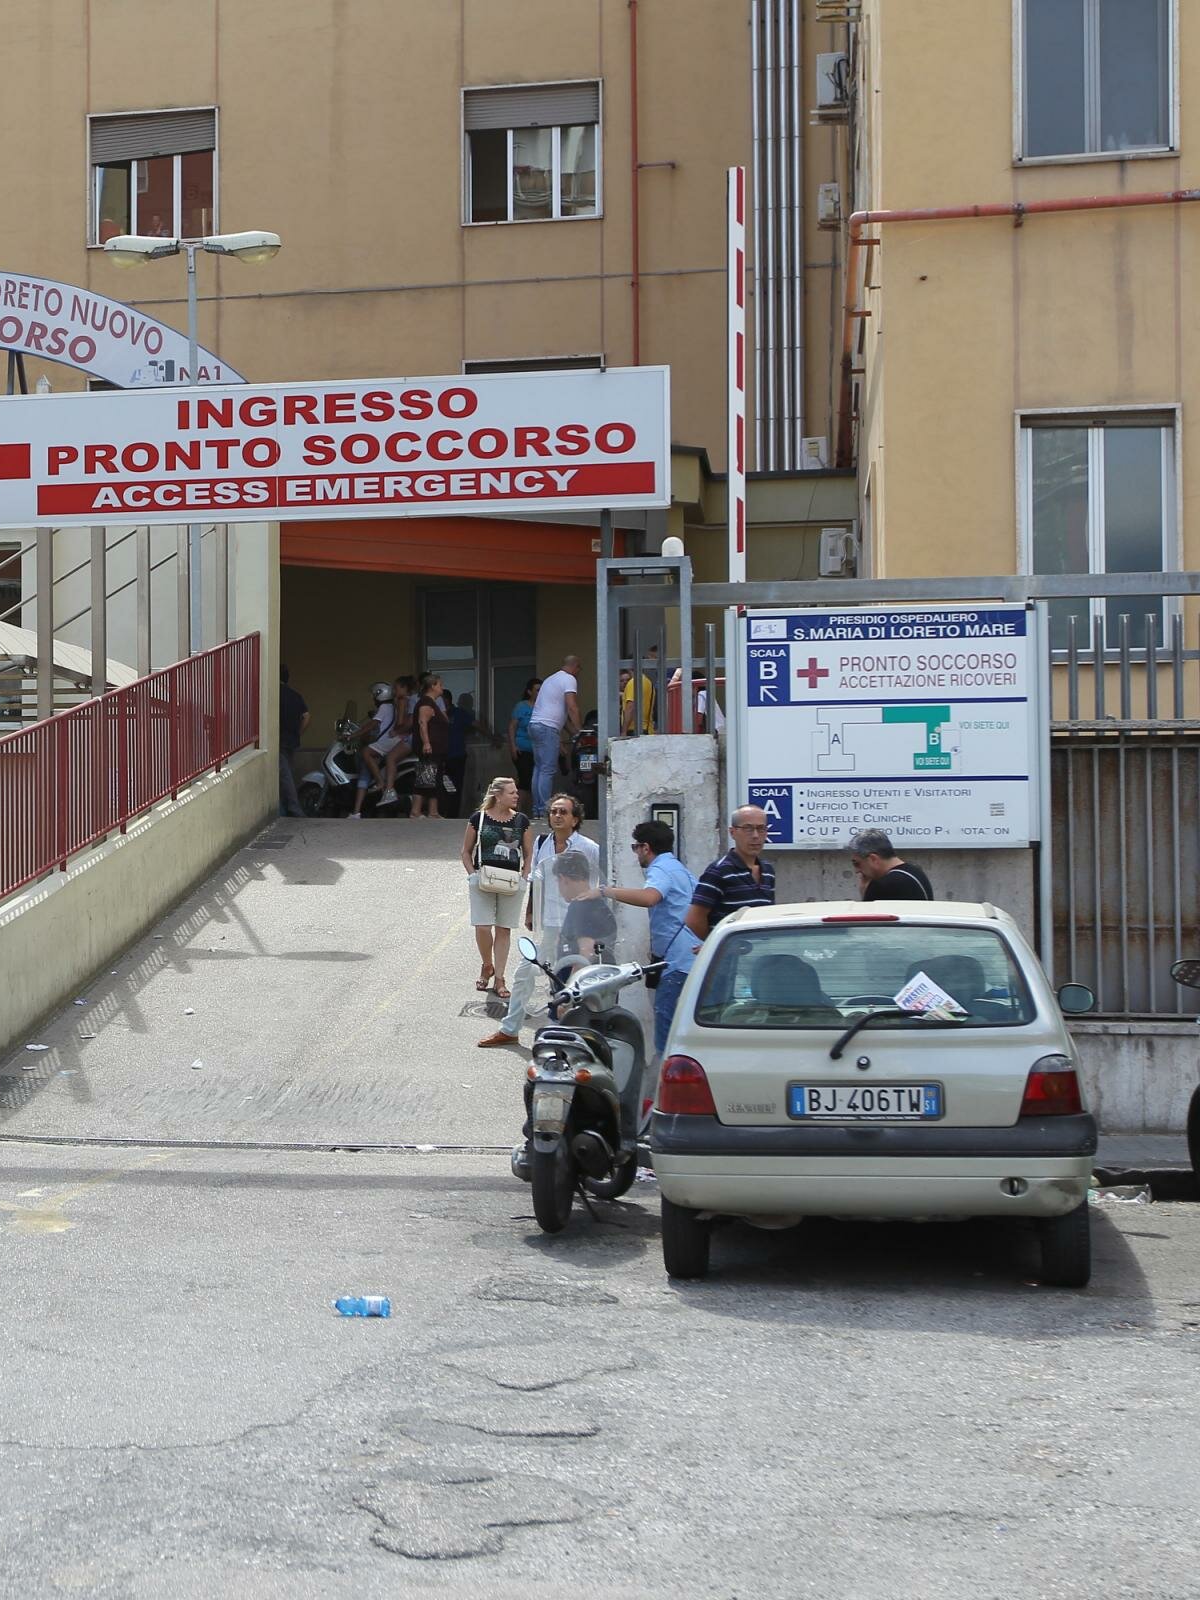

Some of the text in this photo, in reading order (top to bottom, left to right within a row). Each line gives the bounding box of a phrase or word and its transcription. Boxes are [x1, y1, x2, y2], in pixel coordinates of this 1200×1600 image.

[70, 294, 164, 355] NUOVO
[177, 387, 478, 430] INGRESSO
[47, 422, 636, 475] PRONTO SOCCORSO
[91, 469, 579, 508] ACCESS EMERGENCY
[829, 613, 978, 625] PRESIDIO OSPEDALIERO
[793, 623, 1016, 641] S.MARIA DI LORETO MARE
[749, 649, 786, 658] SCALA
[839, 653, 1017, 673] PRONTO SOCCORSO
[759, 662, 778, 680] B
[838, 672, 1017, 689] ACCETTAZIONE RICOVERI
[831, 733, 841, 745] A
[928, 733, 940, 745] B
[752, 788, 789, 797] SCALA
[807, 788, 972, 798] INGRESSO UTENTI E VISITATORI
[764, 800, 781, 819] A
[807, 801, 889, 810] UFFICIO TICKET
[807, 814, 912, 823] CARTELLE CLINICHE
[896, 826, 931, 835] UNICO
